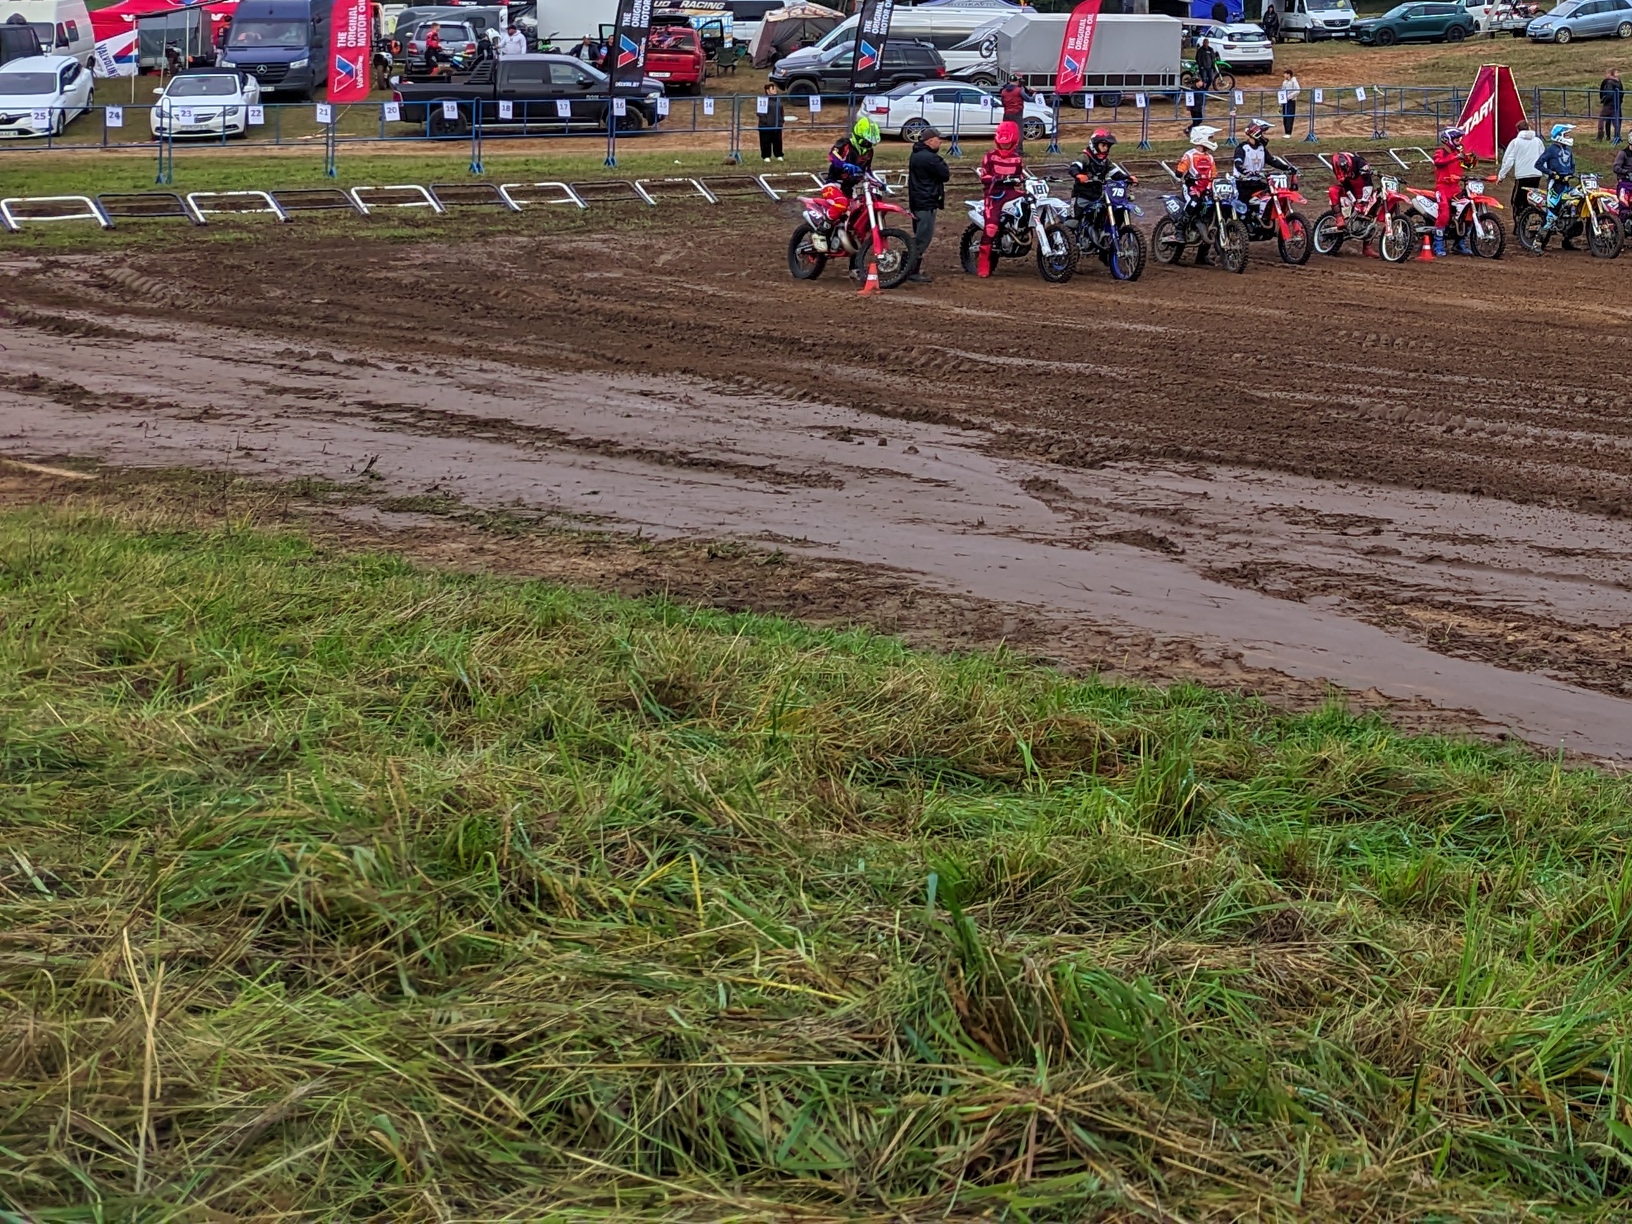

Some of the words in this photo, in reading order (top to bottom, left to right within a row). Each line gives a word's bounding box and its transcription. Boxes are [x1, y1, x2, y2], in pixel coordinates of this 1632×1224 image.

[679, 0, 726, 10] RACING
[622, 12, 632, 27] THE
[640, 0, 652, 28] MOTOR
[872, 1, 885, 35] ORIGINAL
[1086, 13, 1094, 24] OIL
[347, 5, 358, 48] ORIGINAL
[863, 19, 873, 33] THE
[880, 9, 891, 36] MOTOR
[357, 14, 367, 47] MOTOR
[1075, 18, 1087, 51] ORIGINAL
[337, 31, 347, 48] THE
[1067, 37, 1076, 50] THE
[1081, 25, 1092, 51] MOTOR
[356, 56, 364, 89] Valvoline
[34, 112, 47, 121] 25
[108, 111, 121, 120] 24
[250, 109, 262, 117] 22
[318, 108, 329, 116] 21
[1032, 184, 1048, 195] 181
[1215, 184, 1233, 193] 700
[1585, 180, 1598, 189] 30
[1529, 192, 1544, 204] 30
